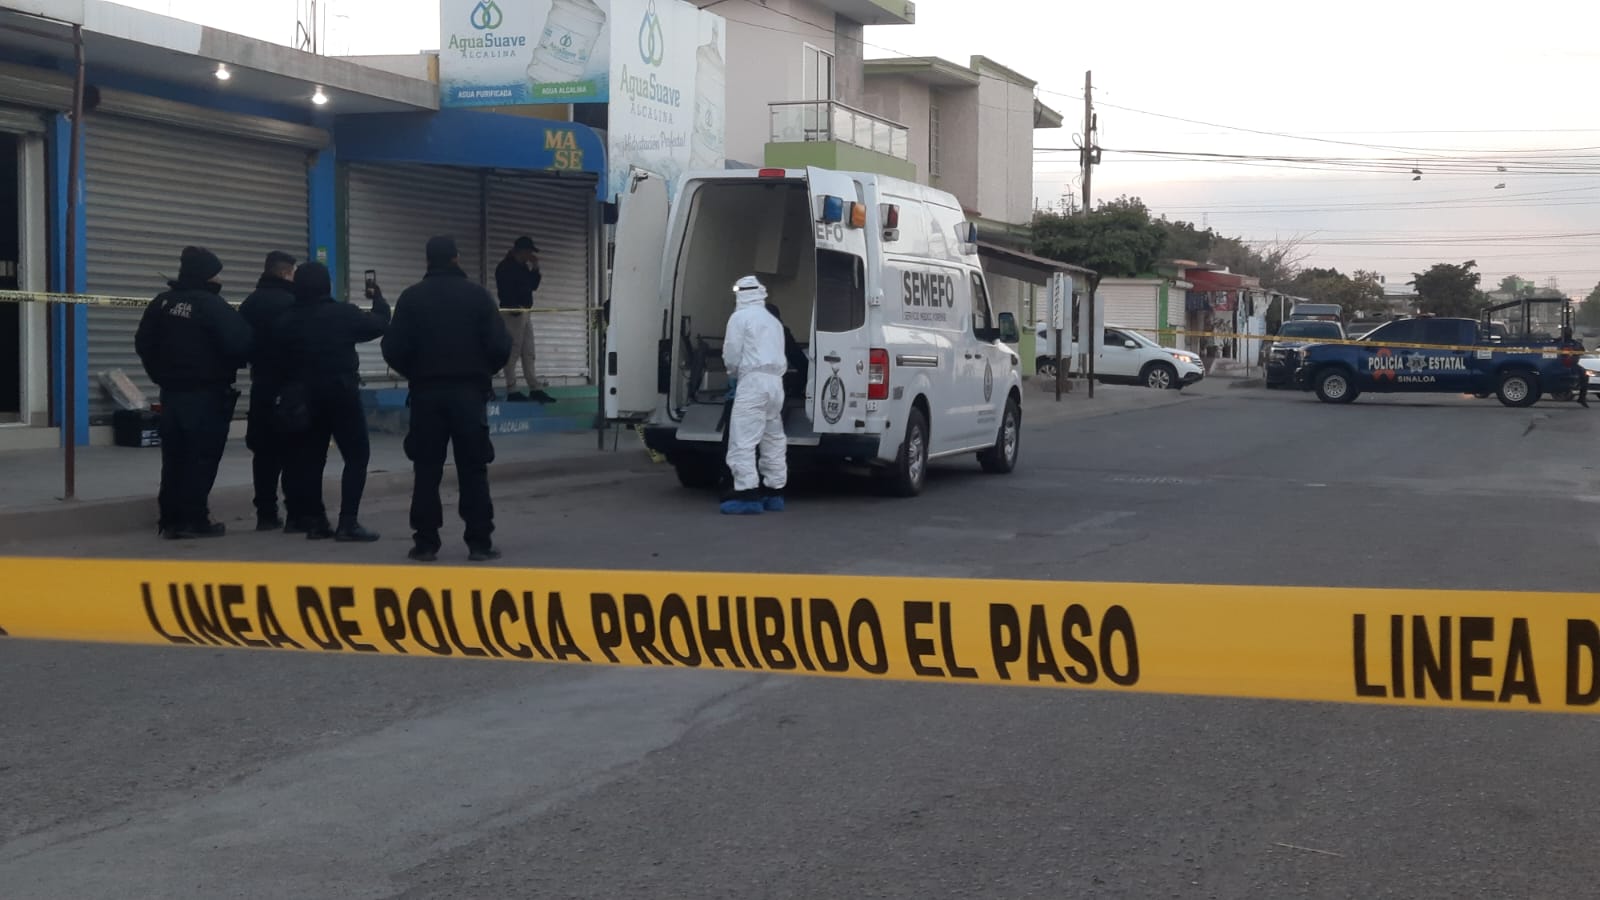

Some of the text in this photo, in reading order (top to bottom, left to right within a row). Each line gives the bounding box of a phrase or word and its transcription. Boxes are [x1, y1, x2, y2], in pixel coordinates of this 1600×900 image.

[448, 32, 527, 52] AguaSuave
[461, 50, 517, 59] ALCALINA
[458, 90, 475, 98] AGUA
[541, 87, 558, 95] AGUA
[620, 63, 681, 108] AguaSuave
[630, 102, 674, 125] ALCALINA
[543, 130, 578, 150] MA
[554, 150, 584, 170] SE
[903, 270, 954, 309] SEMEFO
[1368, 355, 1466, 370] POLICÍA ESTATAL
[1397, 375, 1436, 383] SINALOA
[140, 581, 1140, 687] LINEA DE POLICIA PROHIBIDO EL PASO
[1353, 613, 1542, 704] LINEA
